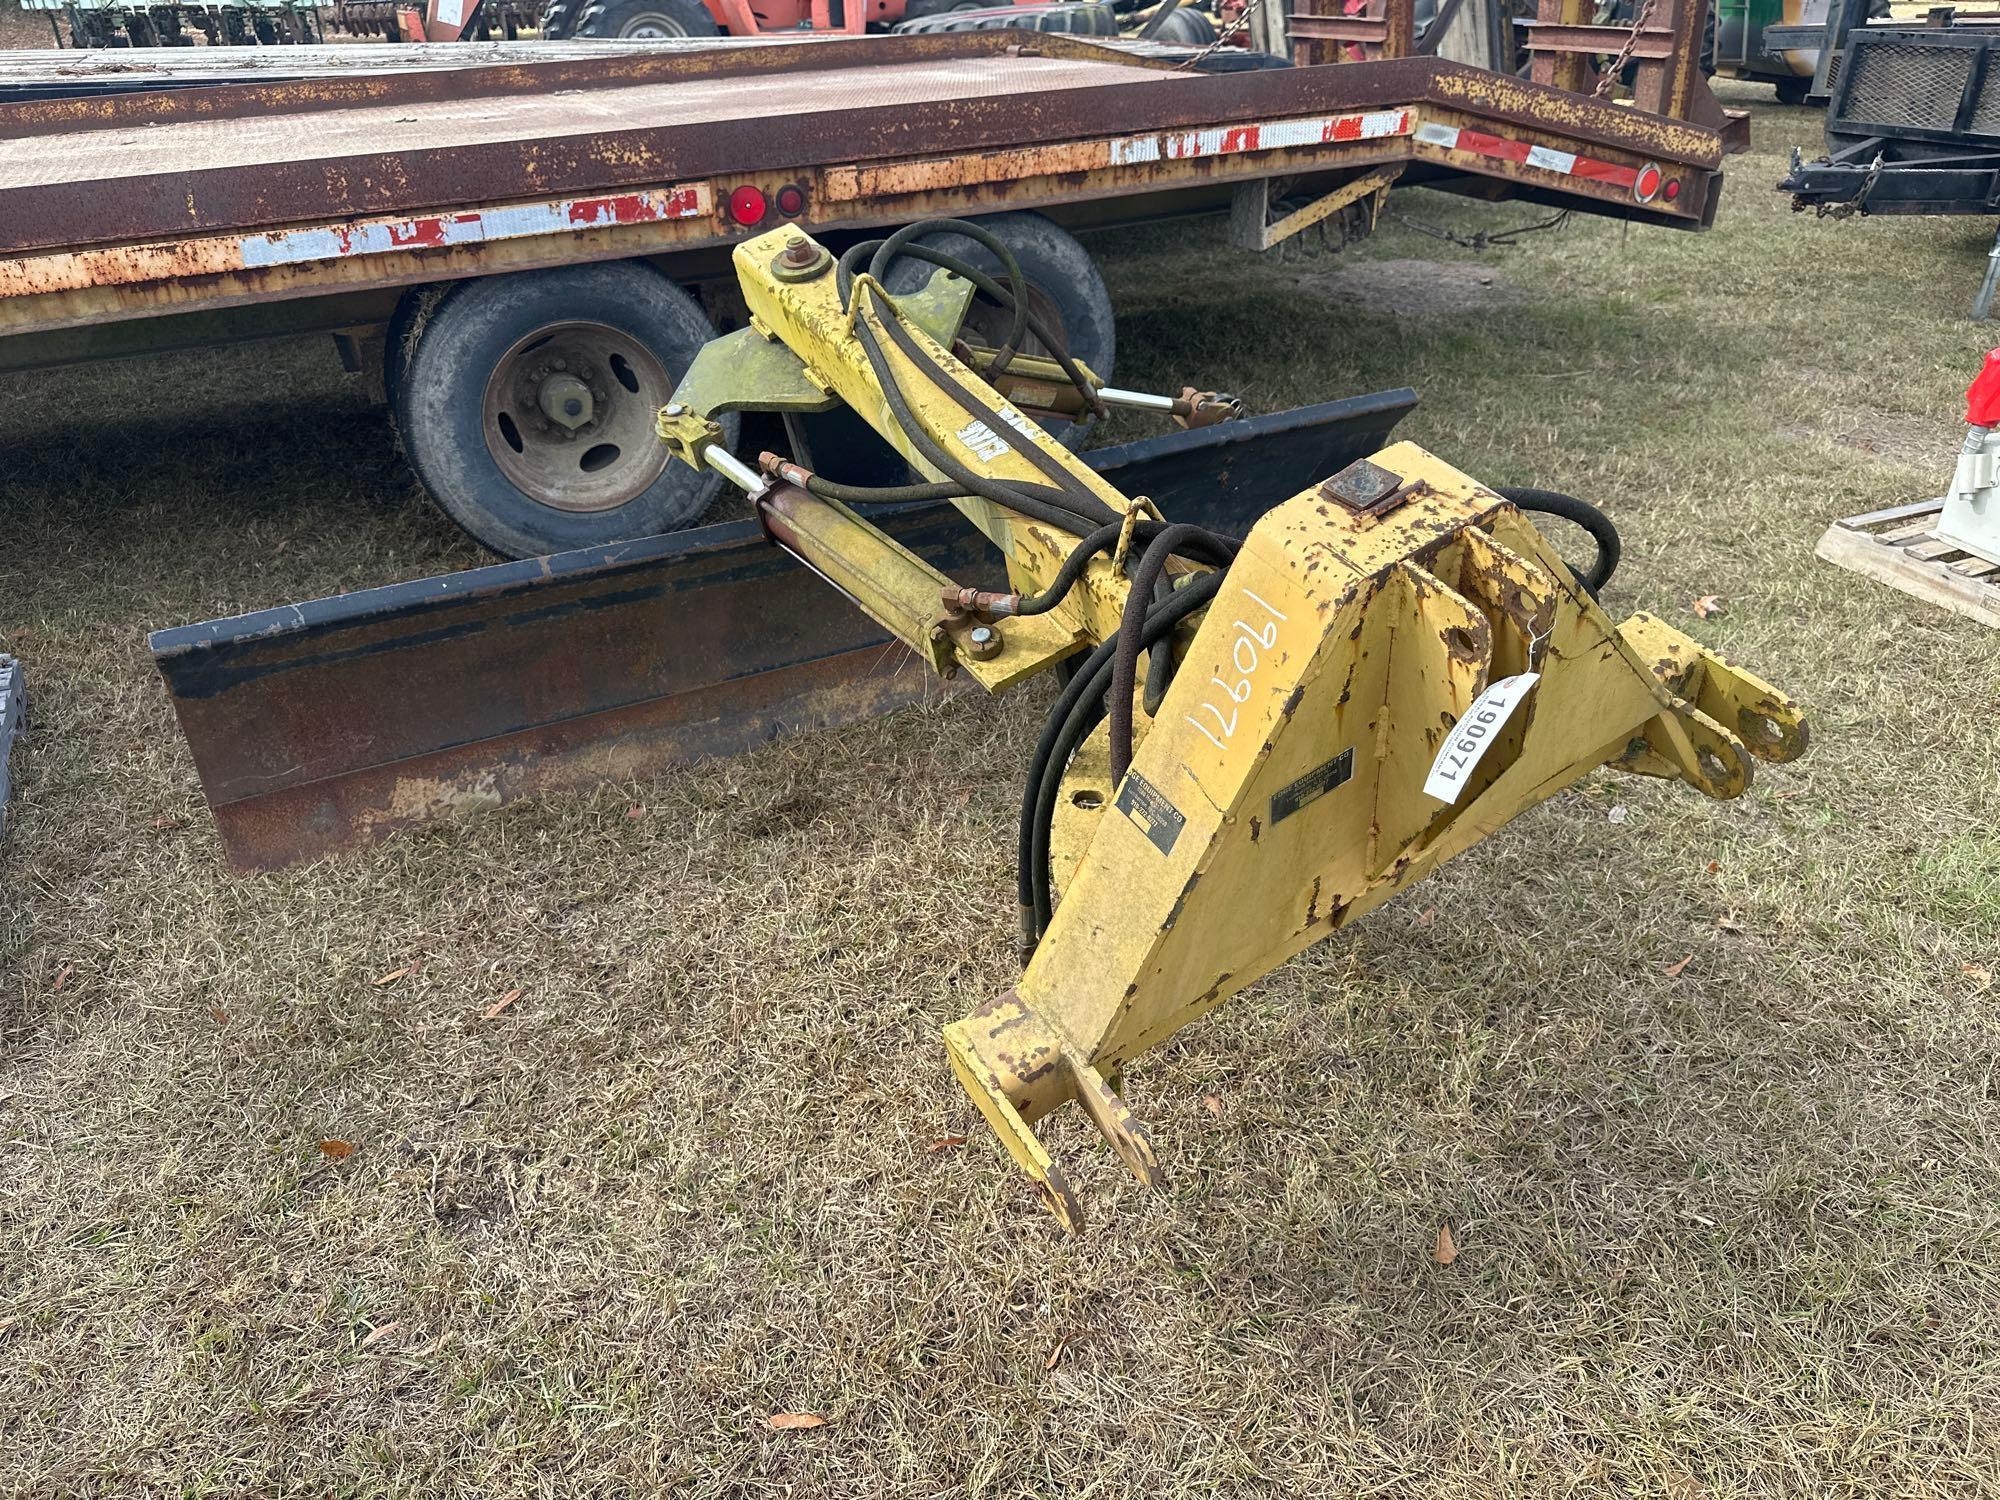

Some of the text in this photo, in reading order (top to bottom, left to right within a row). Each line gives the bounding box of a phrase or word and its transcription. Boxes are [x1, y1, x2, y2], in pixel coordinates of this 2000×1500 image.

[1185, 588, 1288, 751] 190971
[1439, 698, 1507, 781] 190971
[1139, 779, 1175, 815] EQUIPMENT
